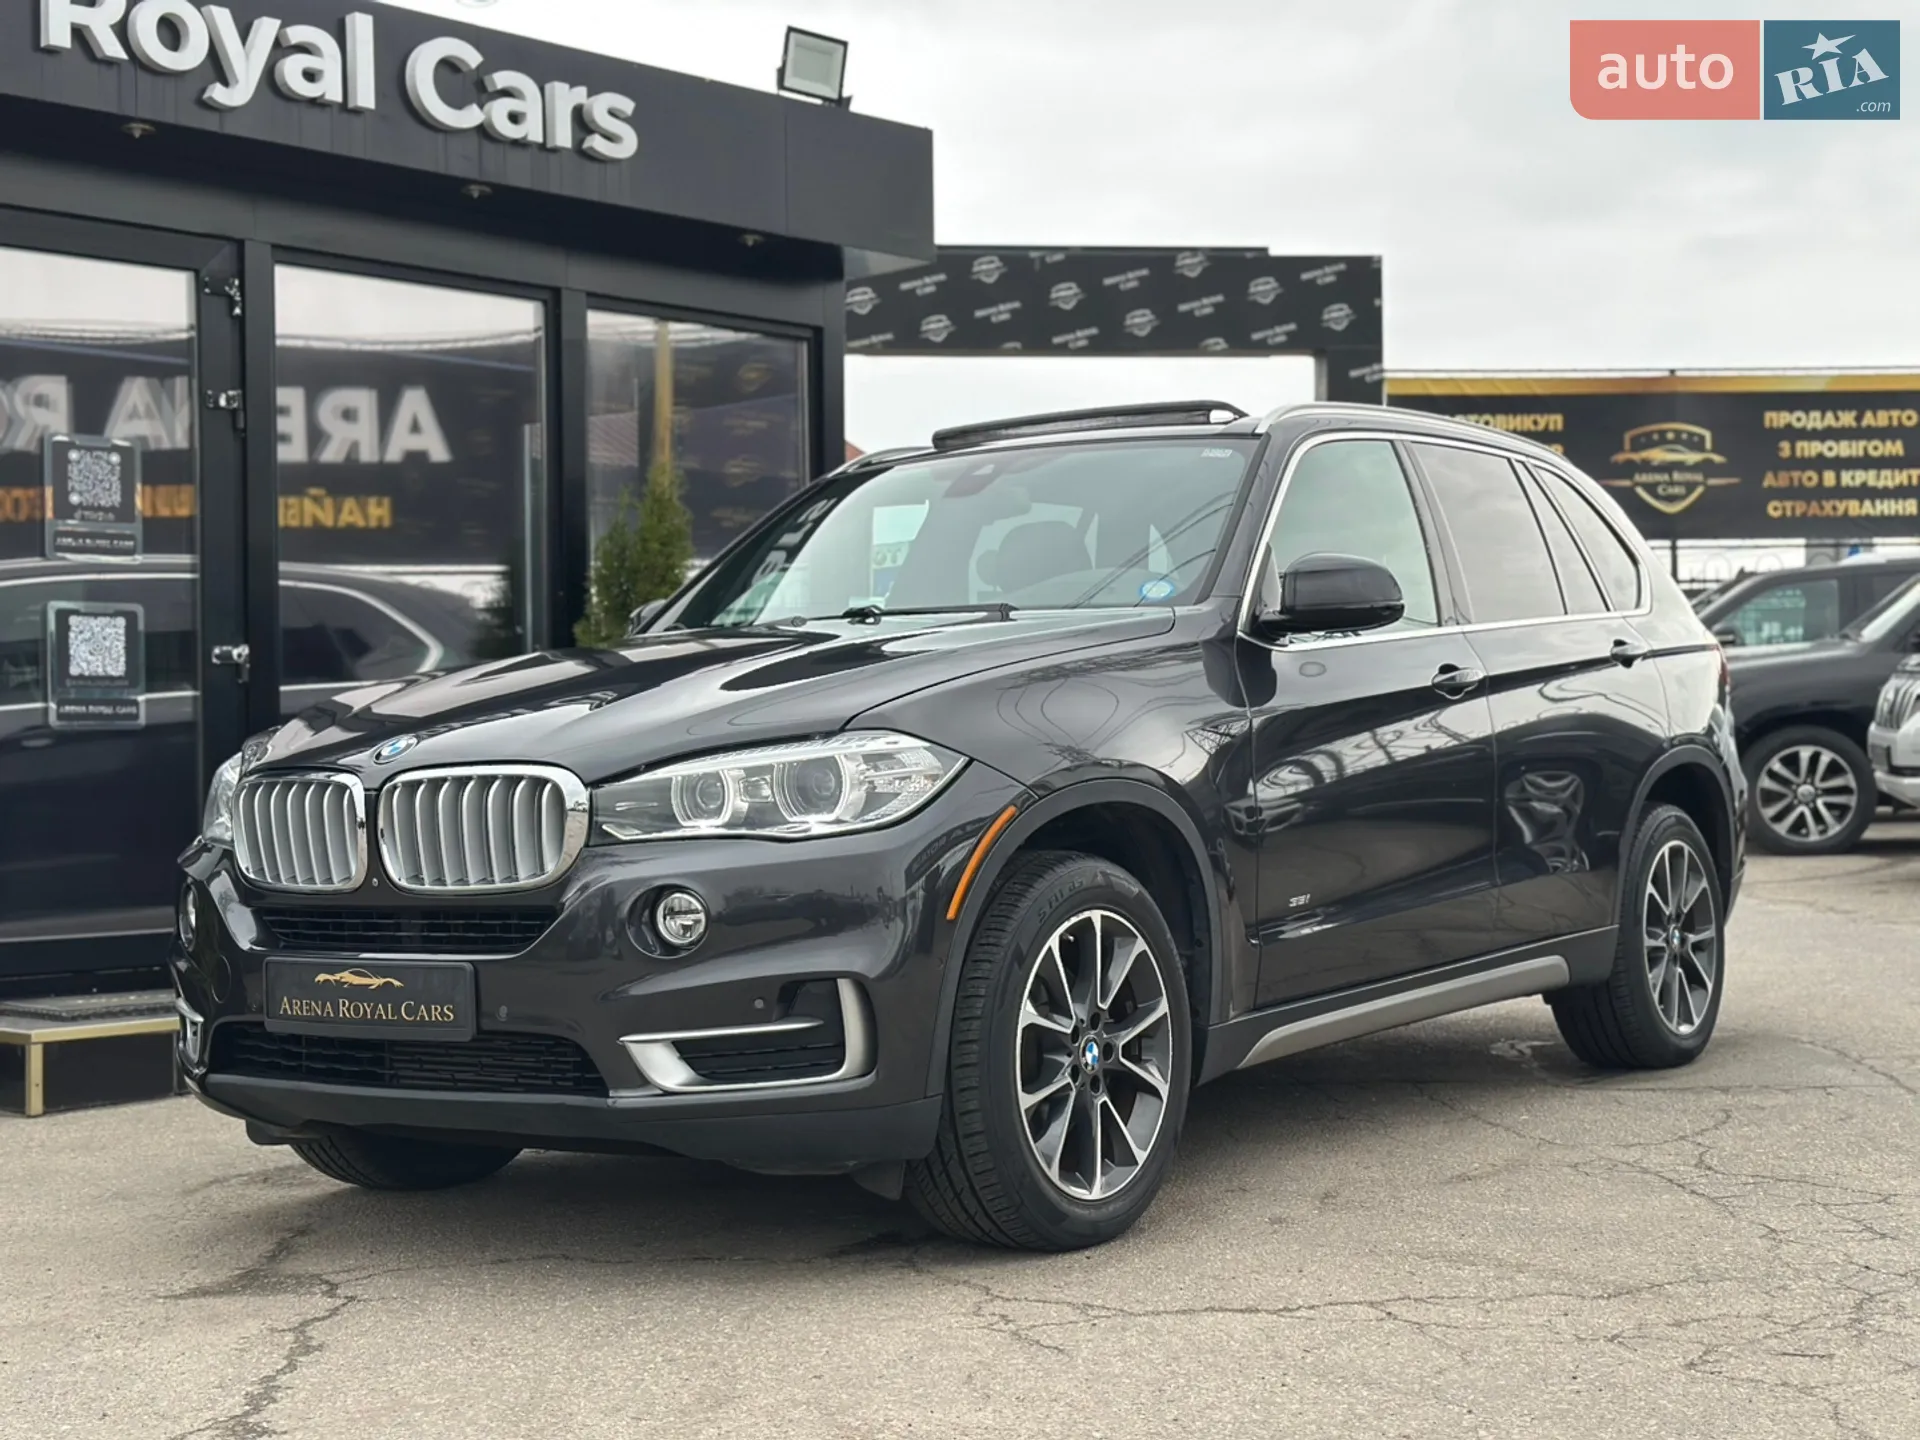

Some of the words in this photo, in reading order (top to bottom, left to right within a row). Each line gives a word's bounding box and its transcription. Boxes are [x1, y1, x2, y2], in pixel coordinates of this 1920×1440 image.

[40, 0, 376, 110] Royal
[405, 36, 639, 162] Cars
[1763, 410, 1858, 430] ПРОДАЖ
[1861, 409, 1919, 428] АВТО
[1794, 438, 1905, 459] ПРОБІГОМ
[1762, 470, 1819, 489] АВТО
[1822, 469, 1837, 488] В
[1839, 468, 1920, 489] КРЕДИТ
[1766, 498, 1918, 520] СТРАХУВАННЯ
[279, 995, 334, 1018] ARENA
[338, 998, 397, 1021] ROYAL
[401, 1000, 455, 1022] CARS
